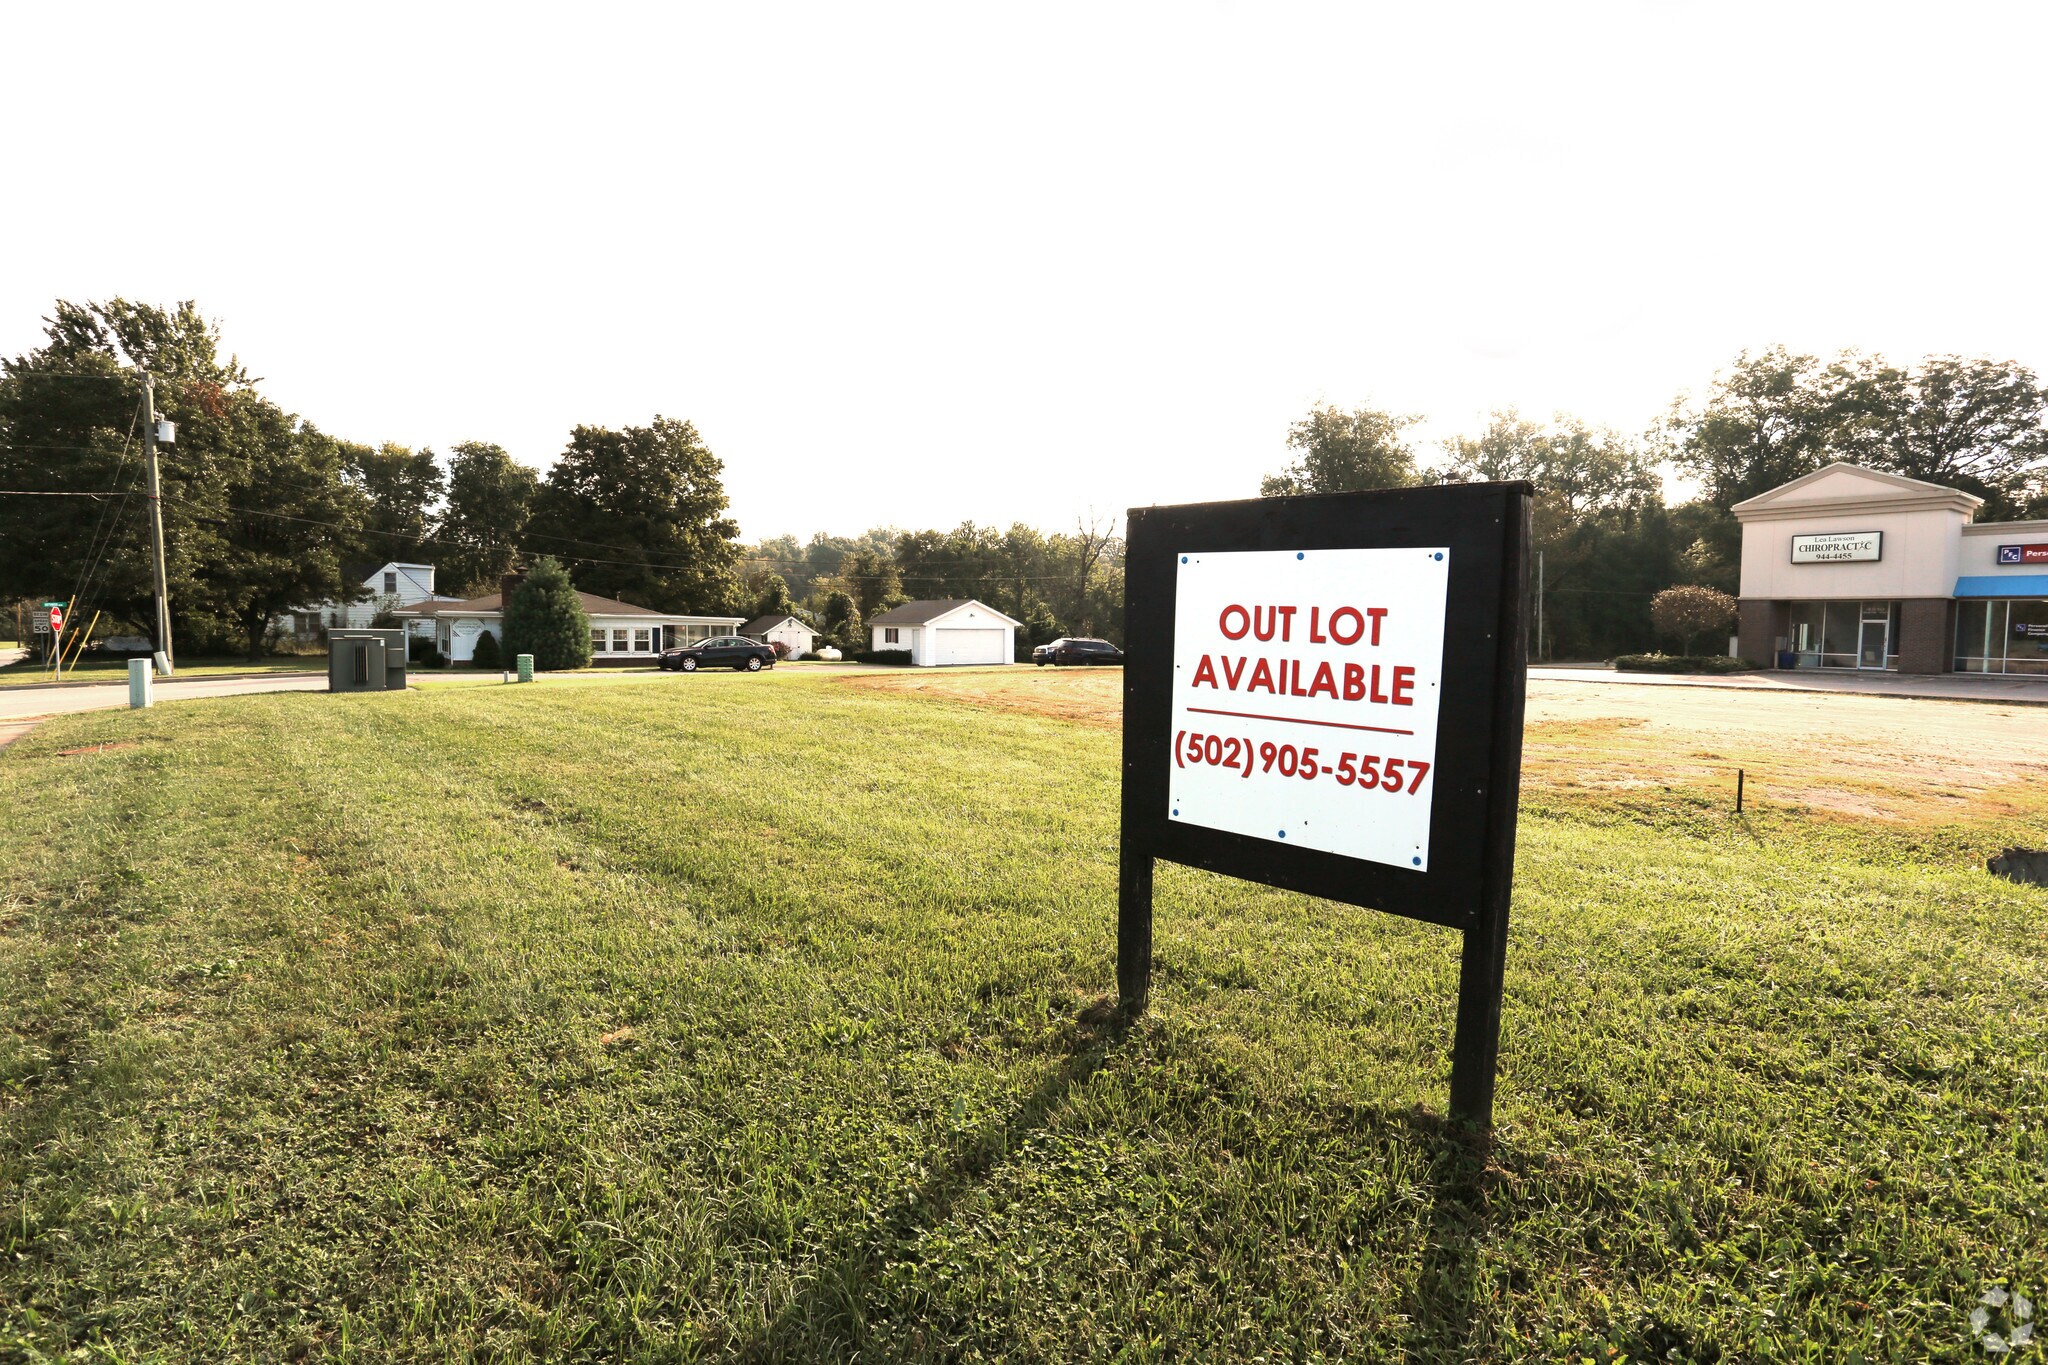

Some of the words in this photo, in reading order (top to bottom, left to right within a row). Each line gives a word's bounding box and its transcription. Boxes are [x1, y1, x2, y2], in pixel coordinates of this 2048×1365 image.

[1815, 552, 1853, 560] 944-4455
[1219, 603, 1297, 641] OUT
[1309, 606, 1388, 646] LOT
[1192, 654, 1415, 706] AVAILABLE
